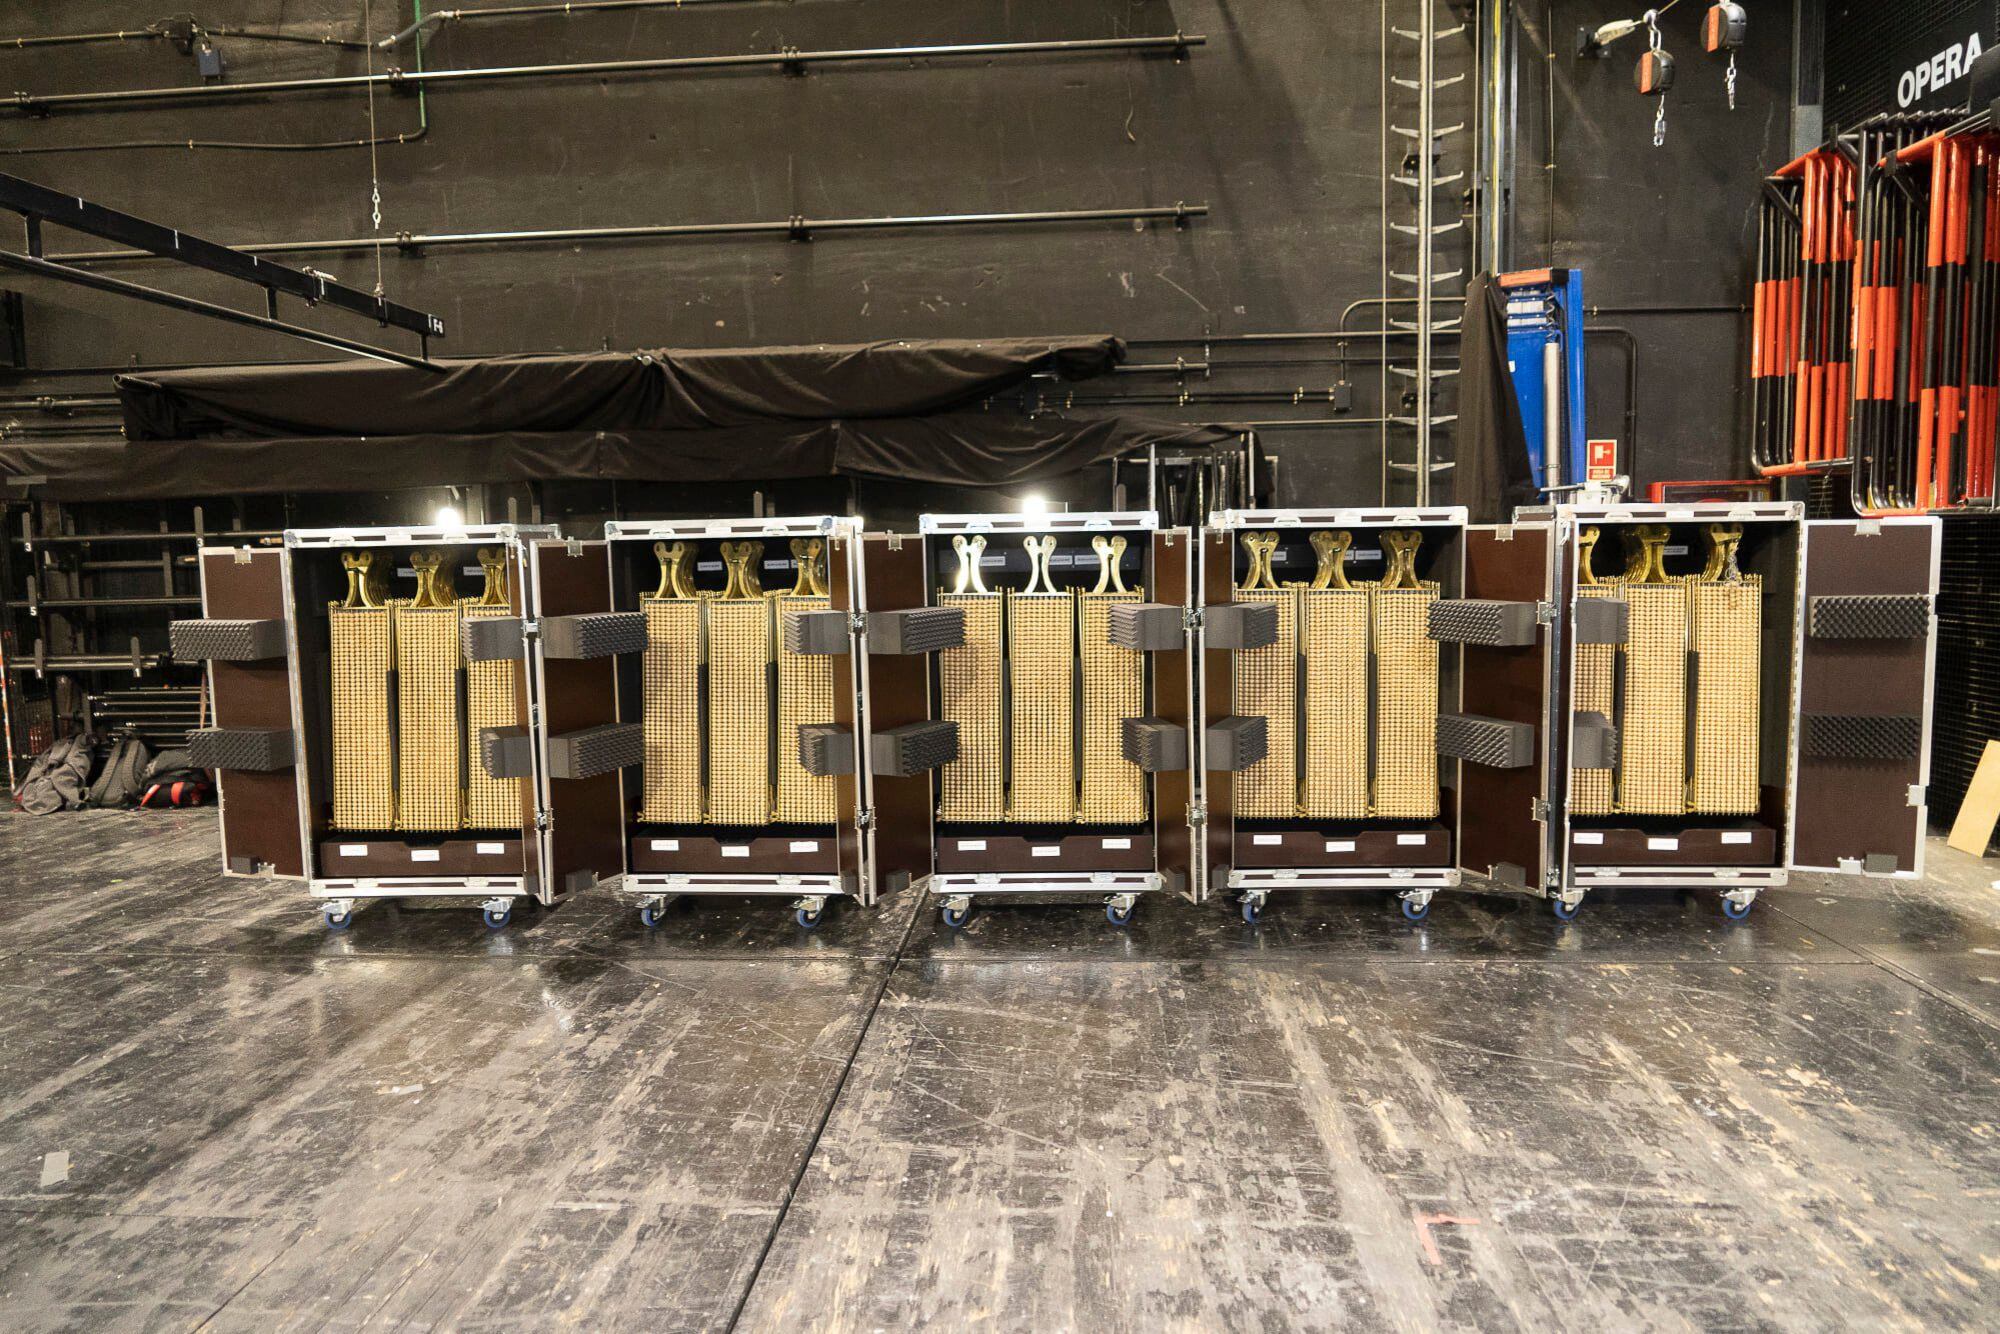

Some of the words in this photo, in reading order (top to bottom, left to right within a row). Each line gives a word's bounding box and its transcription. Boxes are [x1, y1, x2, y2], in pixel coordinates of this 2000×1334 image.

[1898, 32, 1982, 108] OPERA
[24, 542, 32, 553] 3
[30, 606, 37, 616] 5
